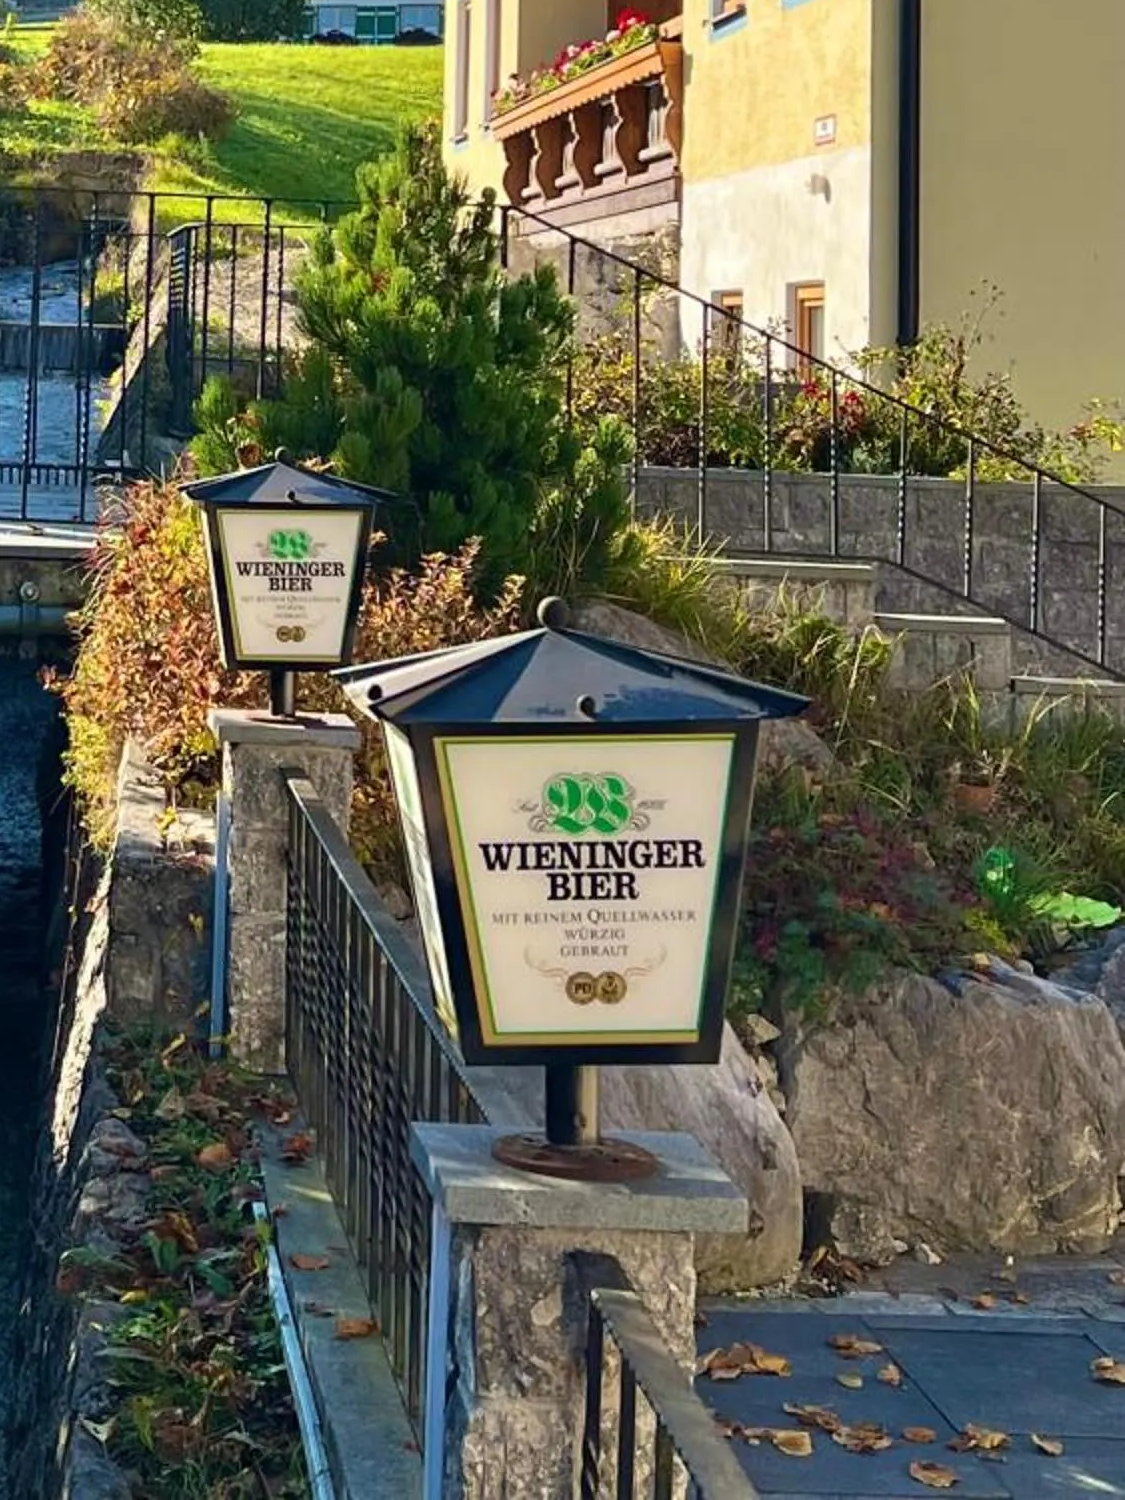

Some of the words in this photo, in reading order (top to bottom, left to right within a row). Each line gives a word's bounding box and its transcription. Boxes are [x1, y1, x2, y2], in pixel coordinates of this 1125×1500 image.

[236, 561, 346, 578] WIENINGER
[268, 577, 313, 592] BIER
[479, 840, 705, 871] WIENINGER
[546, 872, 640, 901] BIER
[492, 913, 520, 924] MIT
[525, 912, 582, 924] REINEM
[587, 908, 697, 924] QUELLWASSER
[564, 928, 625, 940] WÜRZIG
[560, 945, 629, 957] GEBRAUT
